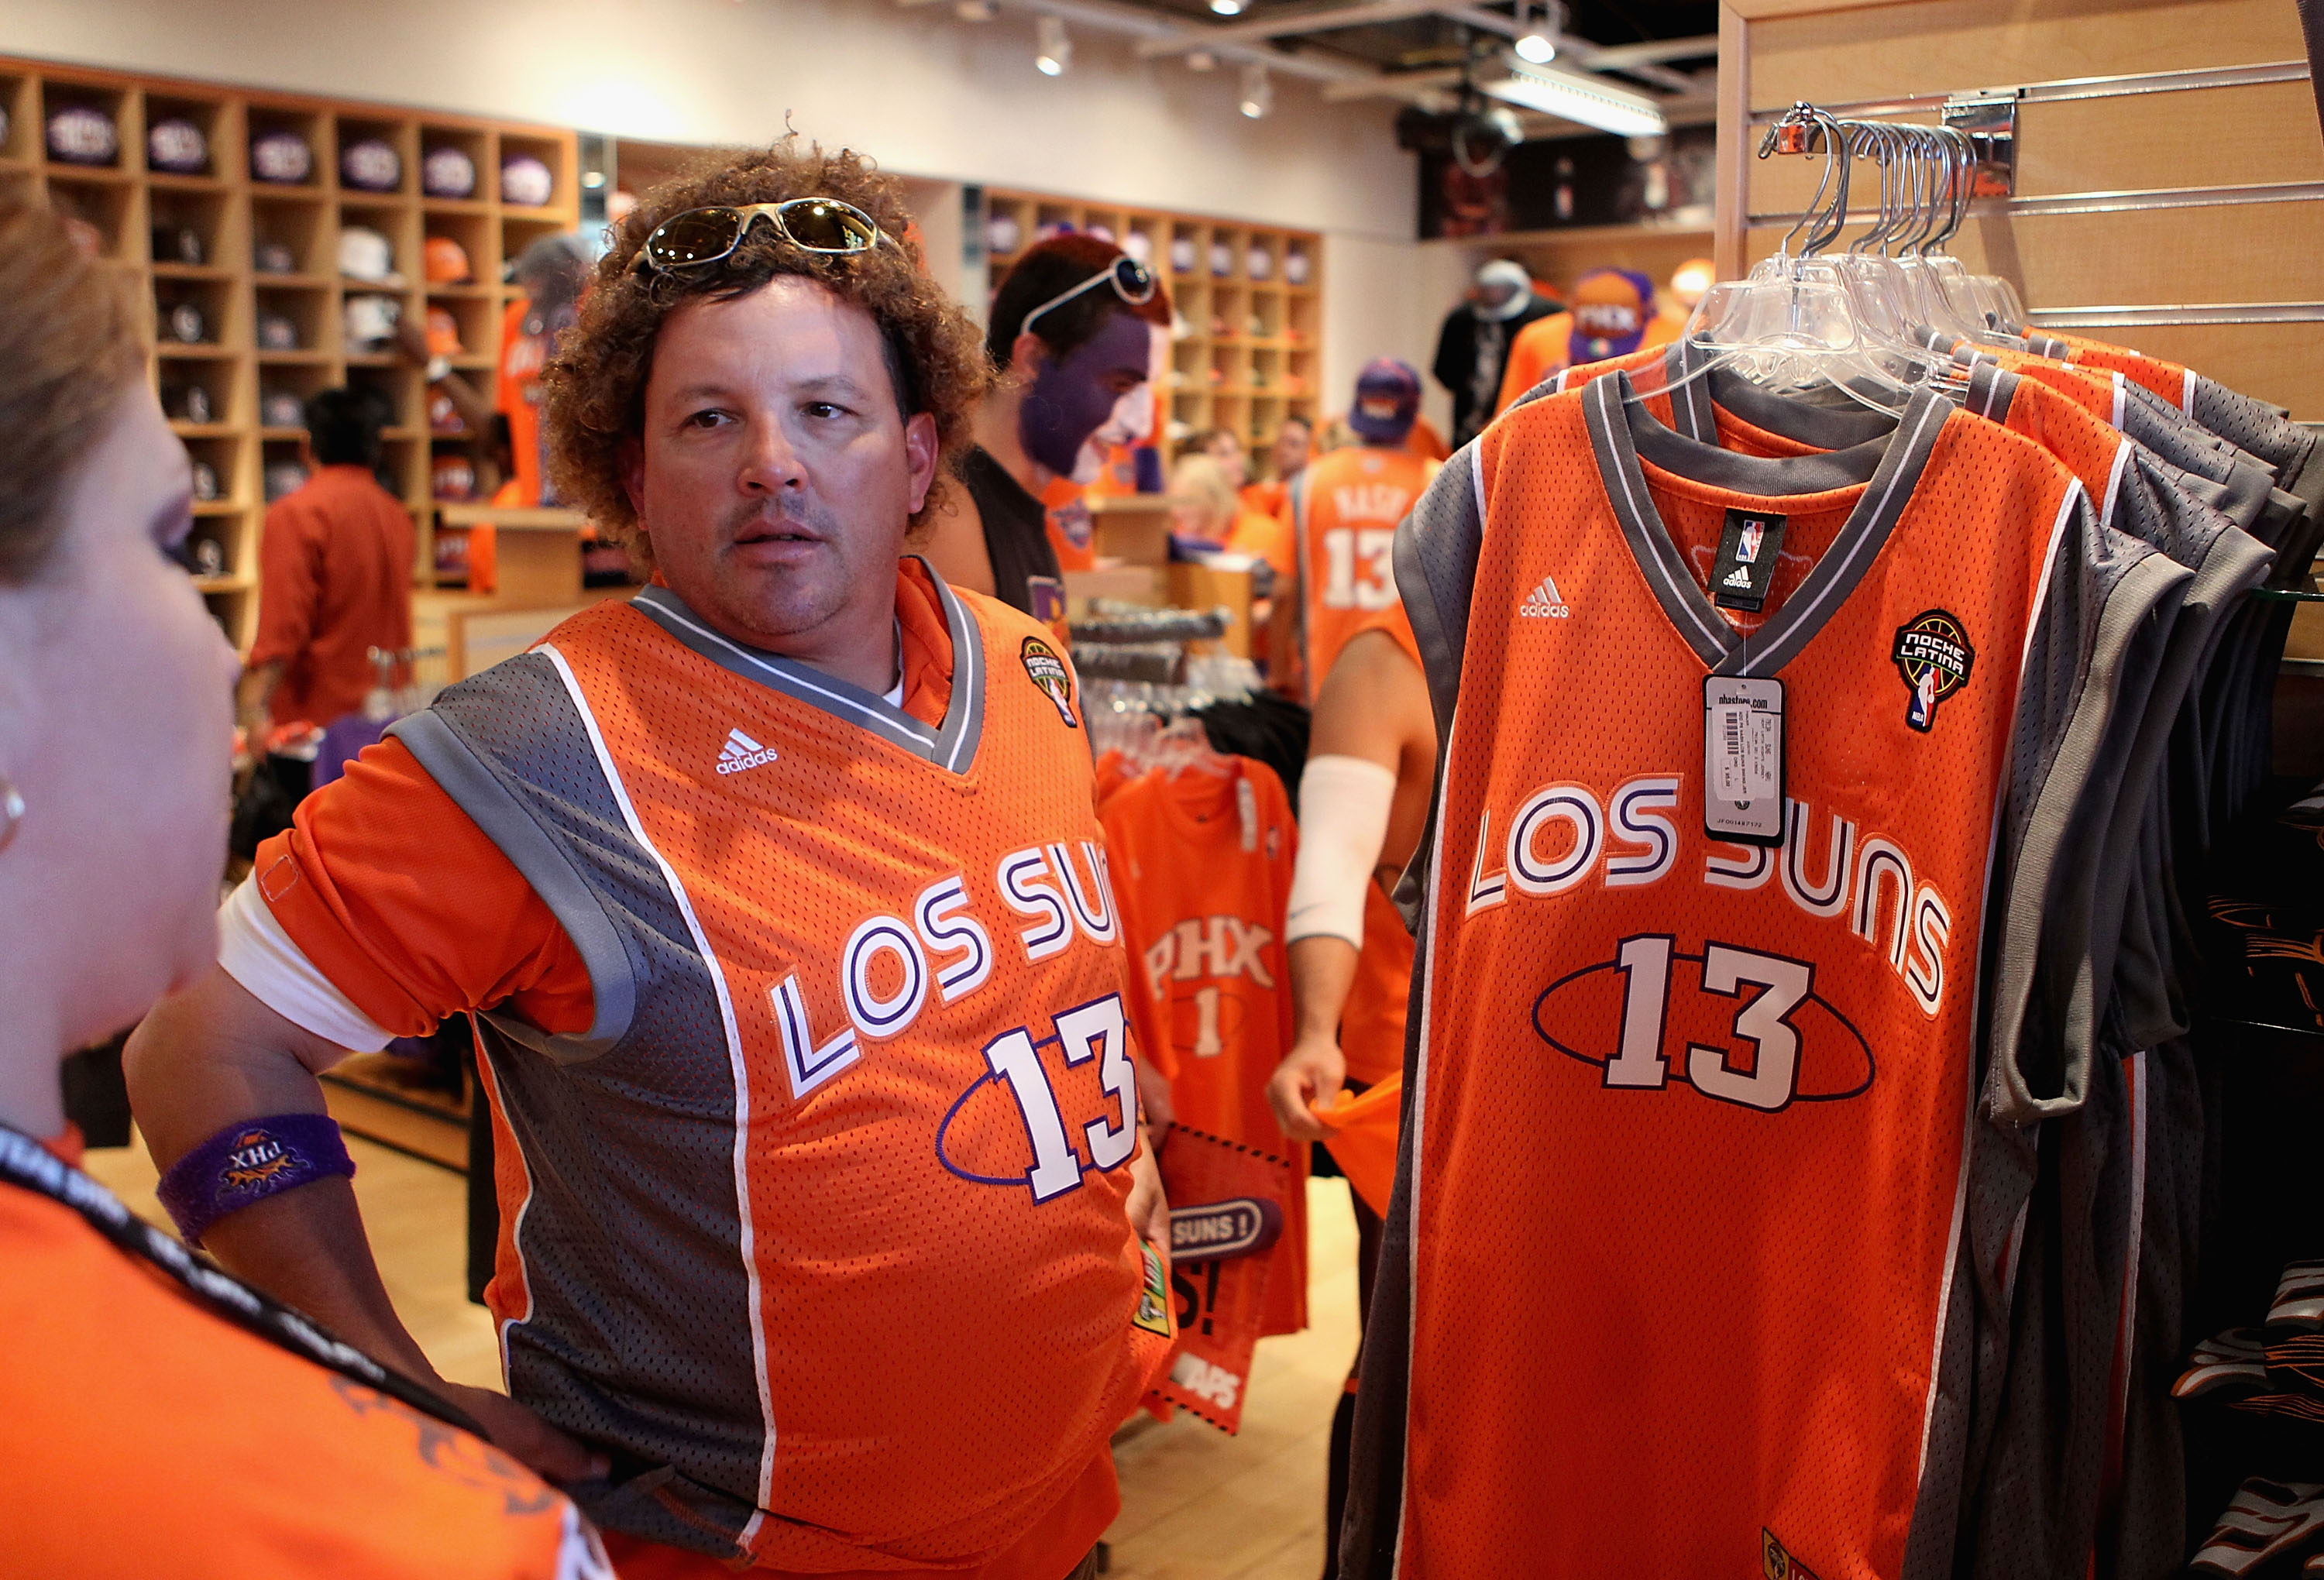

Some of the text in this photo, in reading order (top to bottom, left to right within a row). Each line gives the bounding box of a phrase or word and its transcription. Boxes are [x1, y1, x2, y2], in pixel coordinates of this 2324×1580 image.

[1323, 528, 1399, 610] 13
[1723, 576, 1752, 589] adidas
[1520, 602, 1570, 619] adidas
[1026, 656, 1061, 669] NOCHE
[1900, 645, 1965, 675] LATINA
[1905, 634, 1965, 662] NOCHE
[1029, 666, 1067, 679] LATINA
[1718, 694, 1769, 709] nbastore.com
[1911, 710, 1924, 723] NBA
[715, 747, 779, 775] adidas
[1466, 778, 1679, 919] LOS
[772, 840, 1124, 1099] LOS SU
[1145, 915, 1275, 1001] PHX
[1195, 985, 1223, 1058] 1
[1601, 933, 1817, 1114] 13
[983, 992, 1138, 1205] 13
[228, 1140, 284, 1170] PHX
[1172, 1216, 1234, 1245] SUNS
